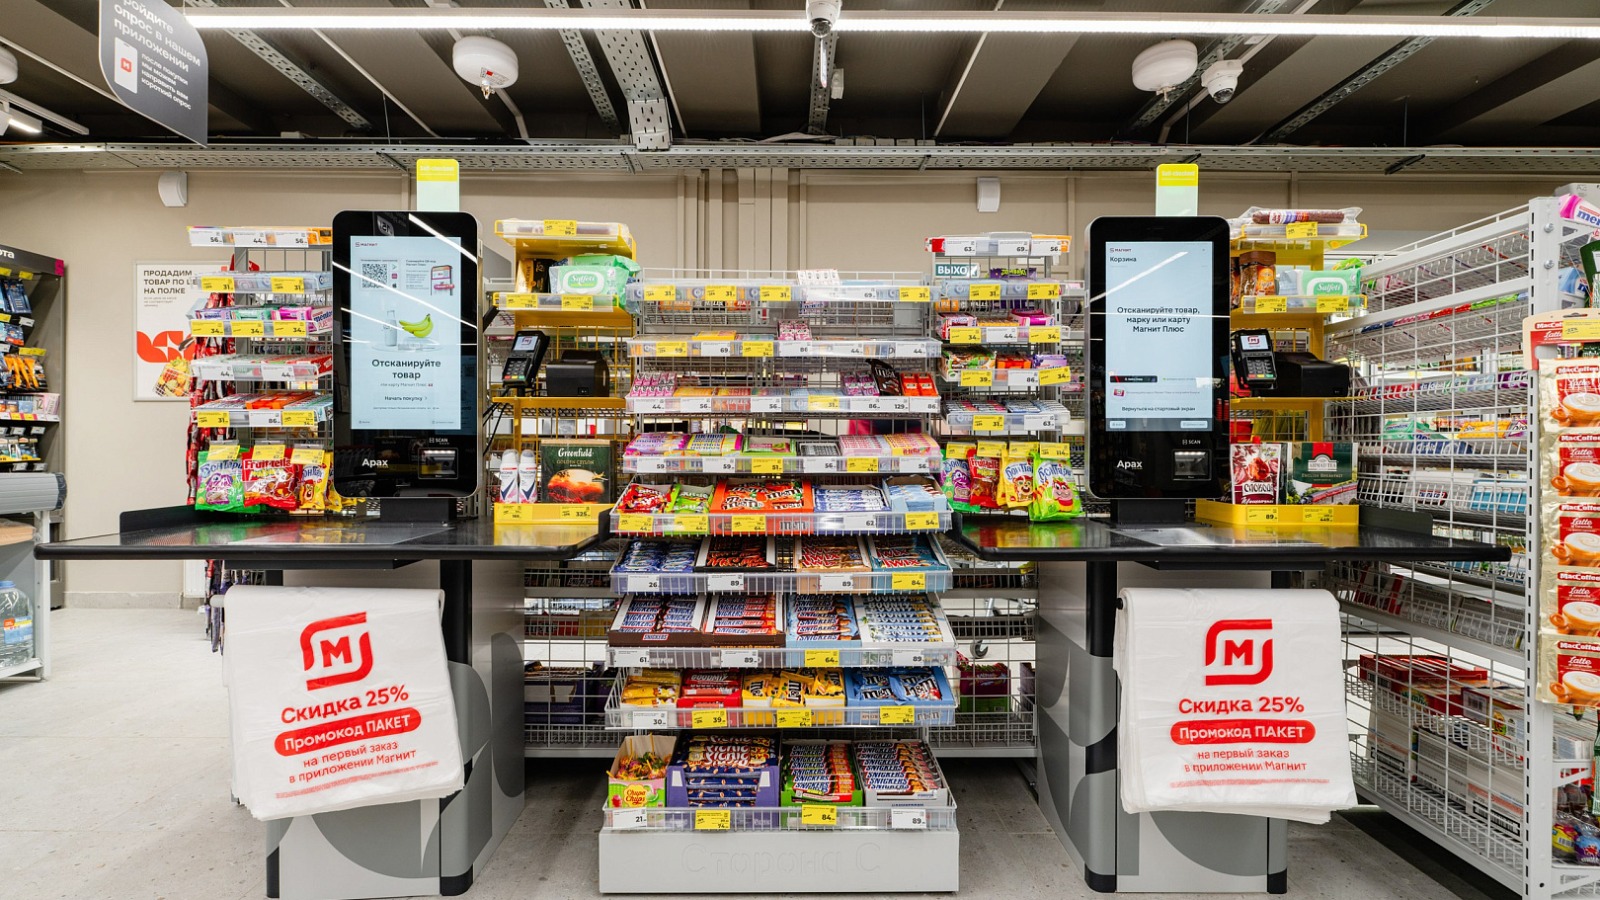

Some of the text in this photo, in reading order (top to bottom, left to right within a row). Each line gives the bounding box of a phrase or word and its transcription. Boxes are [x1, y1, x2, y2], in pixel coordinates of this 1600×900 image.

[124, 0, 174, 34] ройдите
[114, 4, 201, 67] опрос в нашем
[114, 19, 189, 72] приложении
[141, 53, 188, 86] после покупки
[141, 61, 177, 86] мы можем
[141, 69, 189, 100] направить вам
[141, 77, 192, 110] короткий опрос
[143, 278, 185, 286] ТОВАР ПО
[143, 287, 186, 295] НА ПОЛКЕ
[1117, 306, 1200, 315] Отсканируйте товар,
[371, 358, 441, 370] Отсканируйте
[391, 371, 421, 381] товар
[557, 447, 593, 458] Greenfield
[281, 684, 409, 724] Скидка 25%
[1178, 696, 1305, 715] Скидка 25%
[283, 714, 411, 752] Промокод ПАКЕТ
[1179, 725, 1306, 742] Промокод ПАКЕТ
[303, 741, 398, 768] на первый заказ
[1197, 748, 1290, 760] на первый заказ
[288, 749, 417, 784] в приложении Магнит
[1185, 761, 1307, 774] в приложении Магнит
[625, 795, 646, 804] Chups
[627, 789, 646, 797] Chupa
